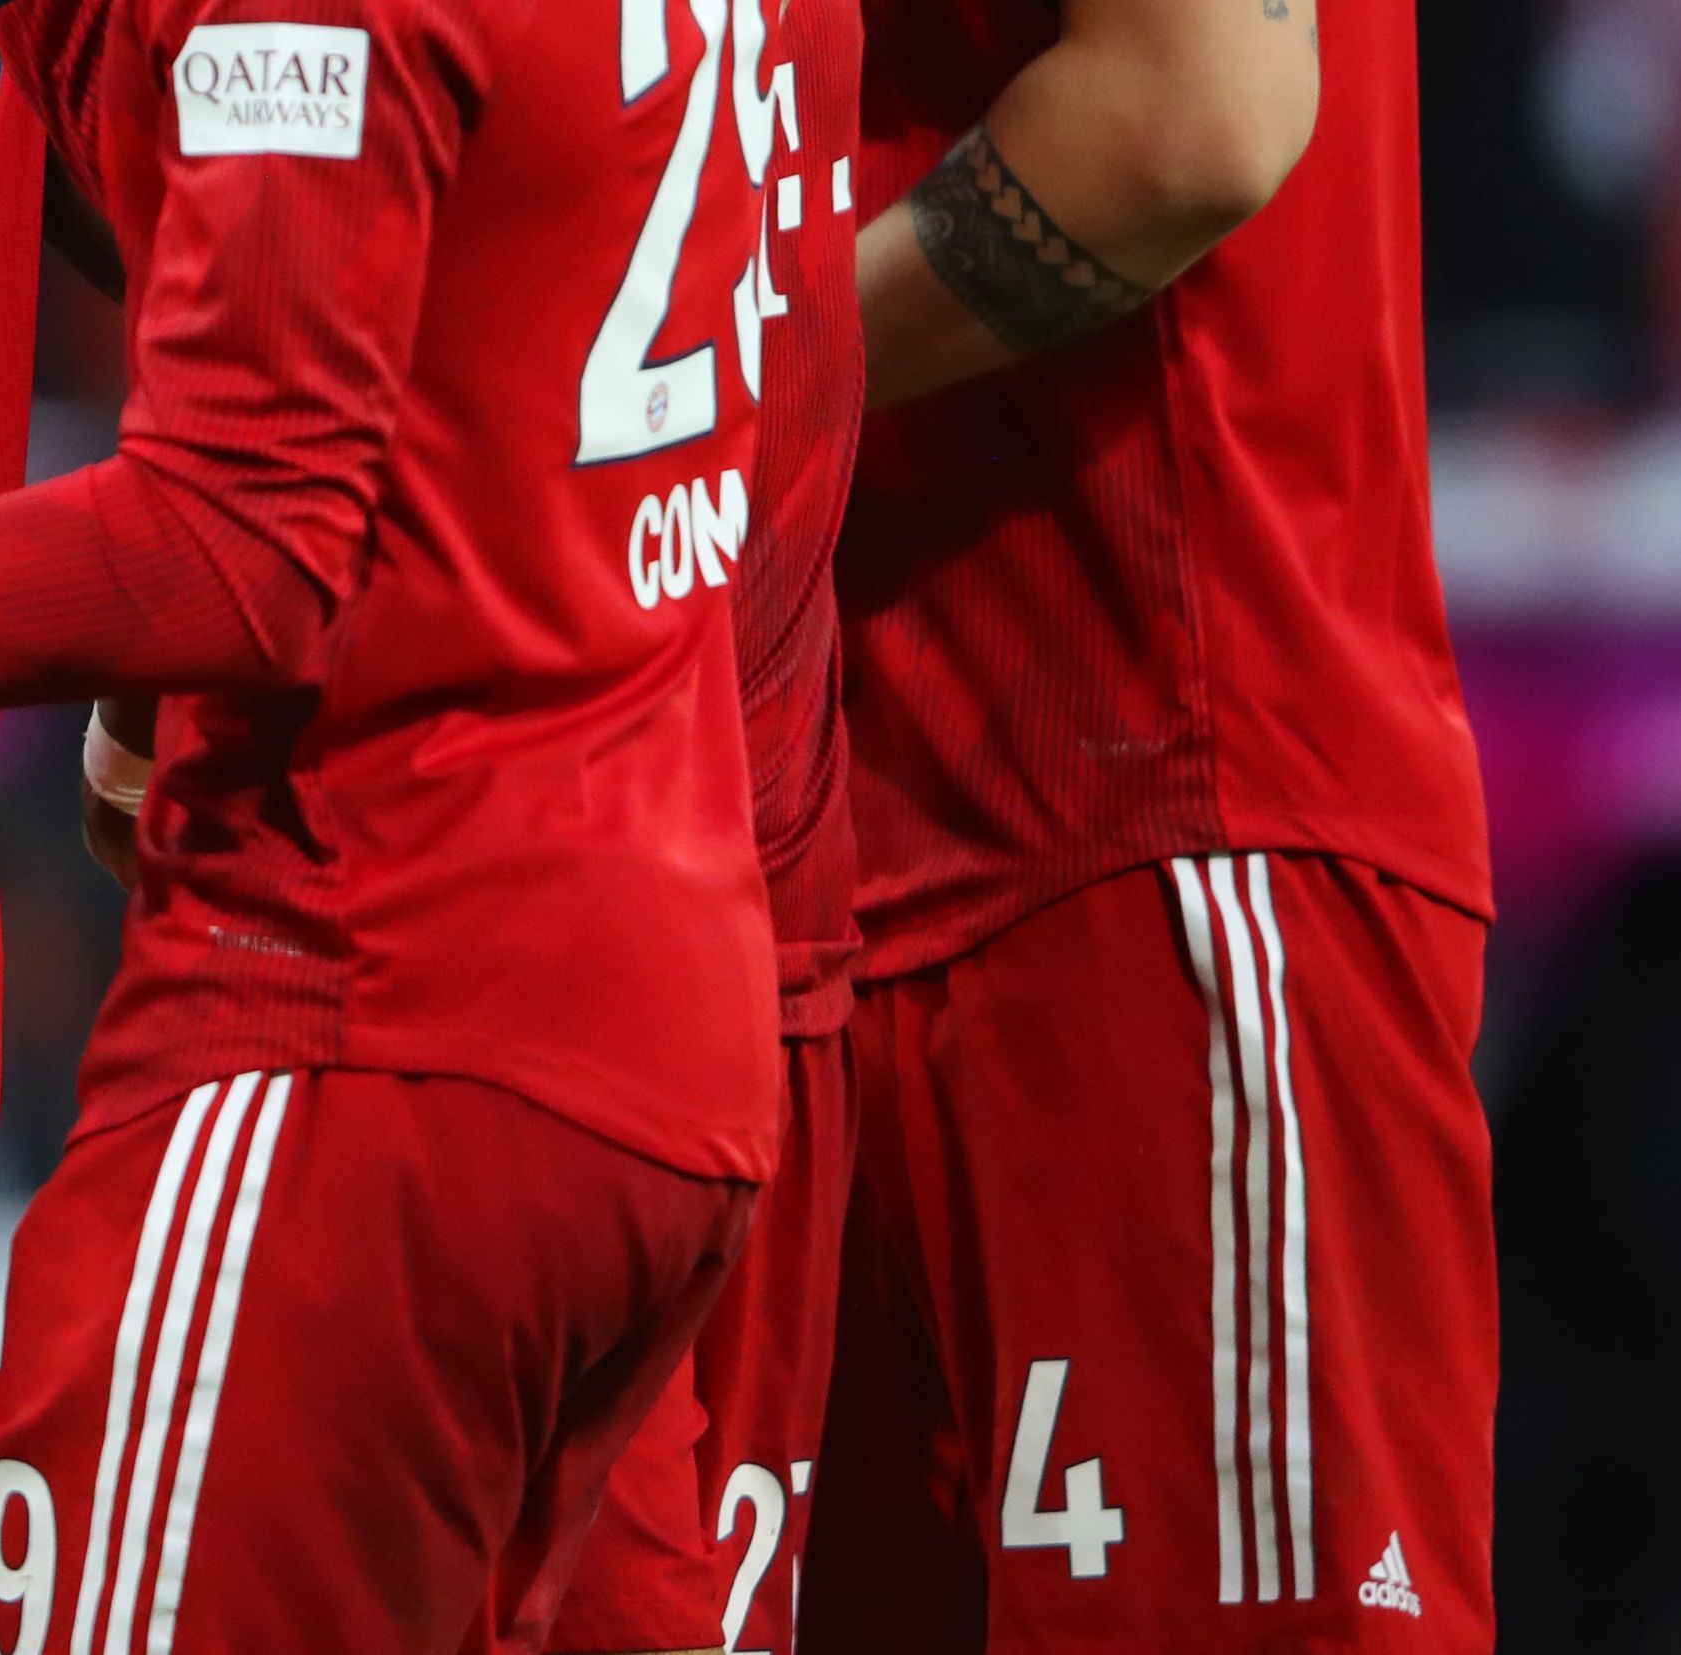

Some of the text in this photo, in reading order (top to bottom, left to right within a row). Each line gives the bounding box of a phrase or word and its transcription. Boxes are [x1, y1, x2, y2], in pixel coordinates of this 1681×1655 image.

[182, 48, 351, 105] QATAR
[226, 98, 350, 129] AIRWAYS
[628, 468, 749, 610] COM
[1000, 1357, 1124, 1580] 4
[1358, 1580, 1422, 1619] adidas
